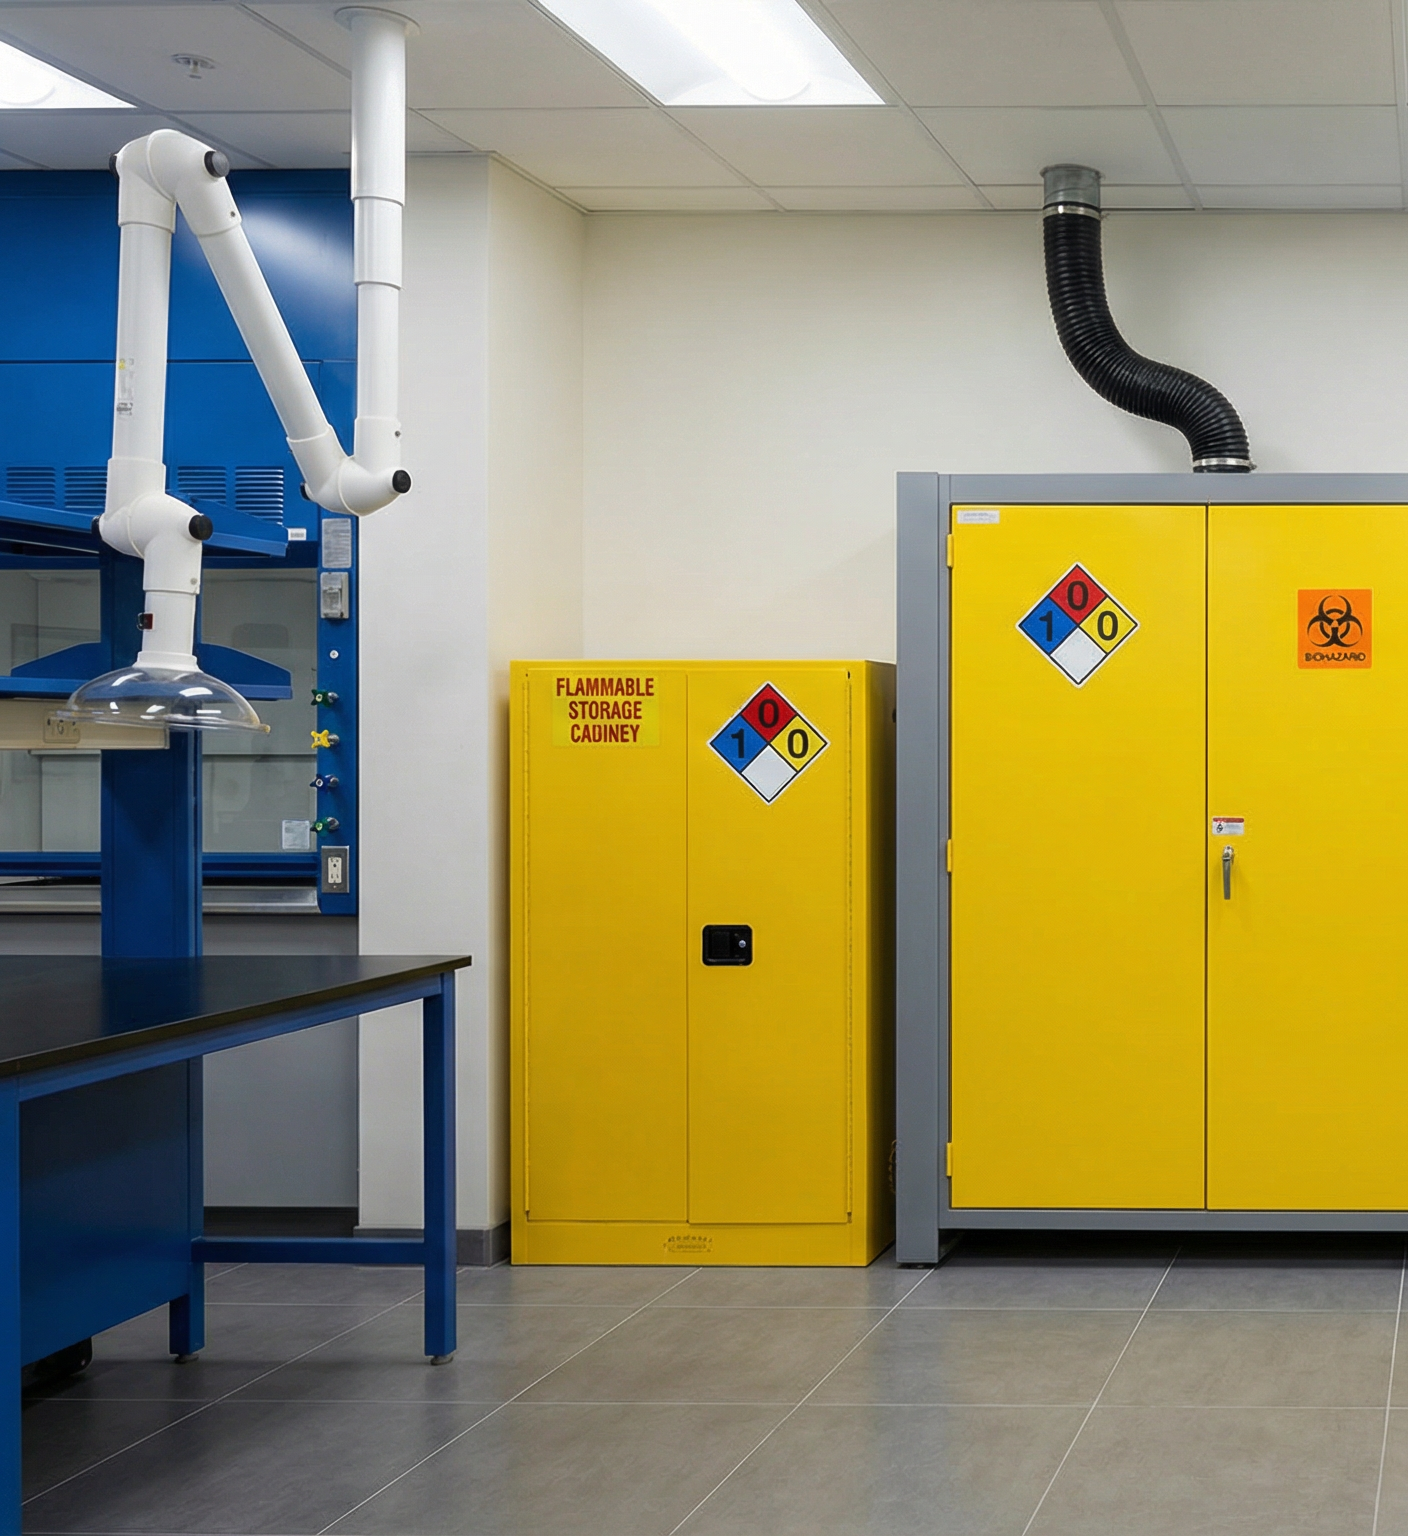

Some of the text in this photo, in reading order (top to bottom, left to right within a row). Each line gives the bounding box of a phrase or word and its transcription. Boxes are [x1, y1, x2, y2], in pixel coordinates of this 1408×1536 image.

[1067, 580, 1089, 611] 0
[1039, 610, 1119, 642] 1 0
[556, 677, 655, 697] FLAMMABLE
[568, 700, 643, 720] STORAGE
[758, 698, 780, 729] 0
[730, 728, 809, 759] 1 0
